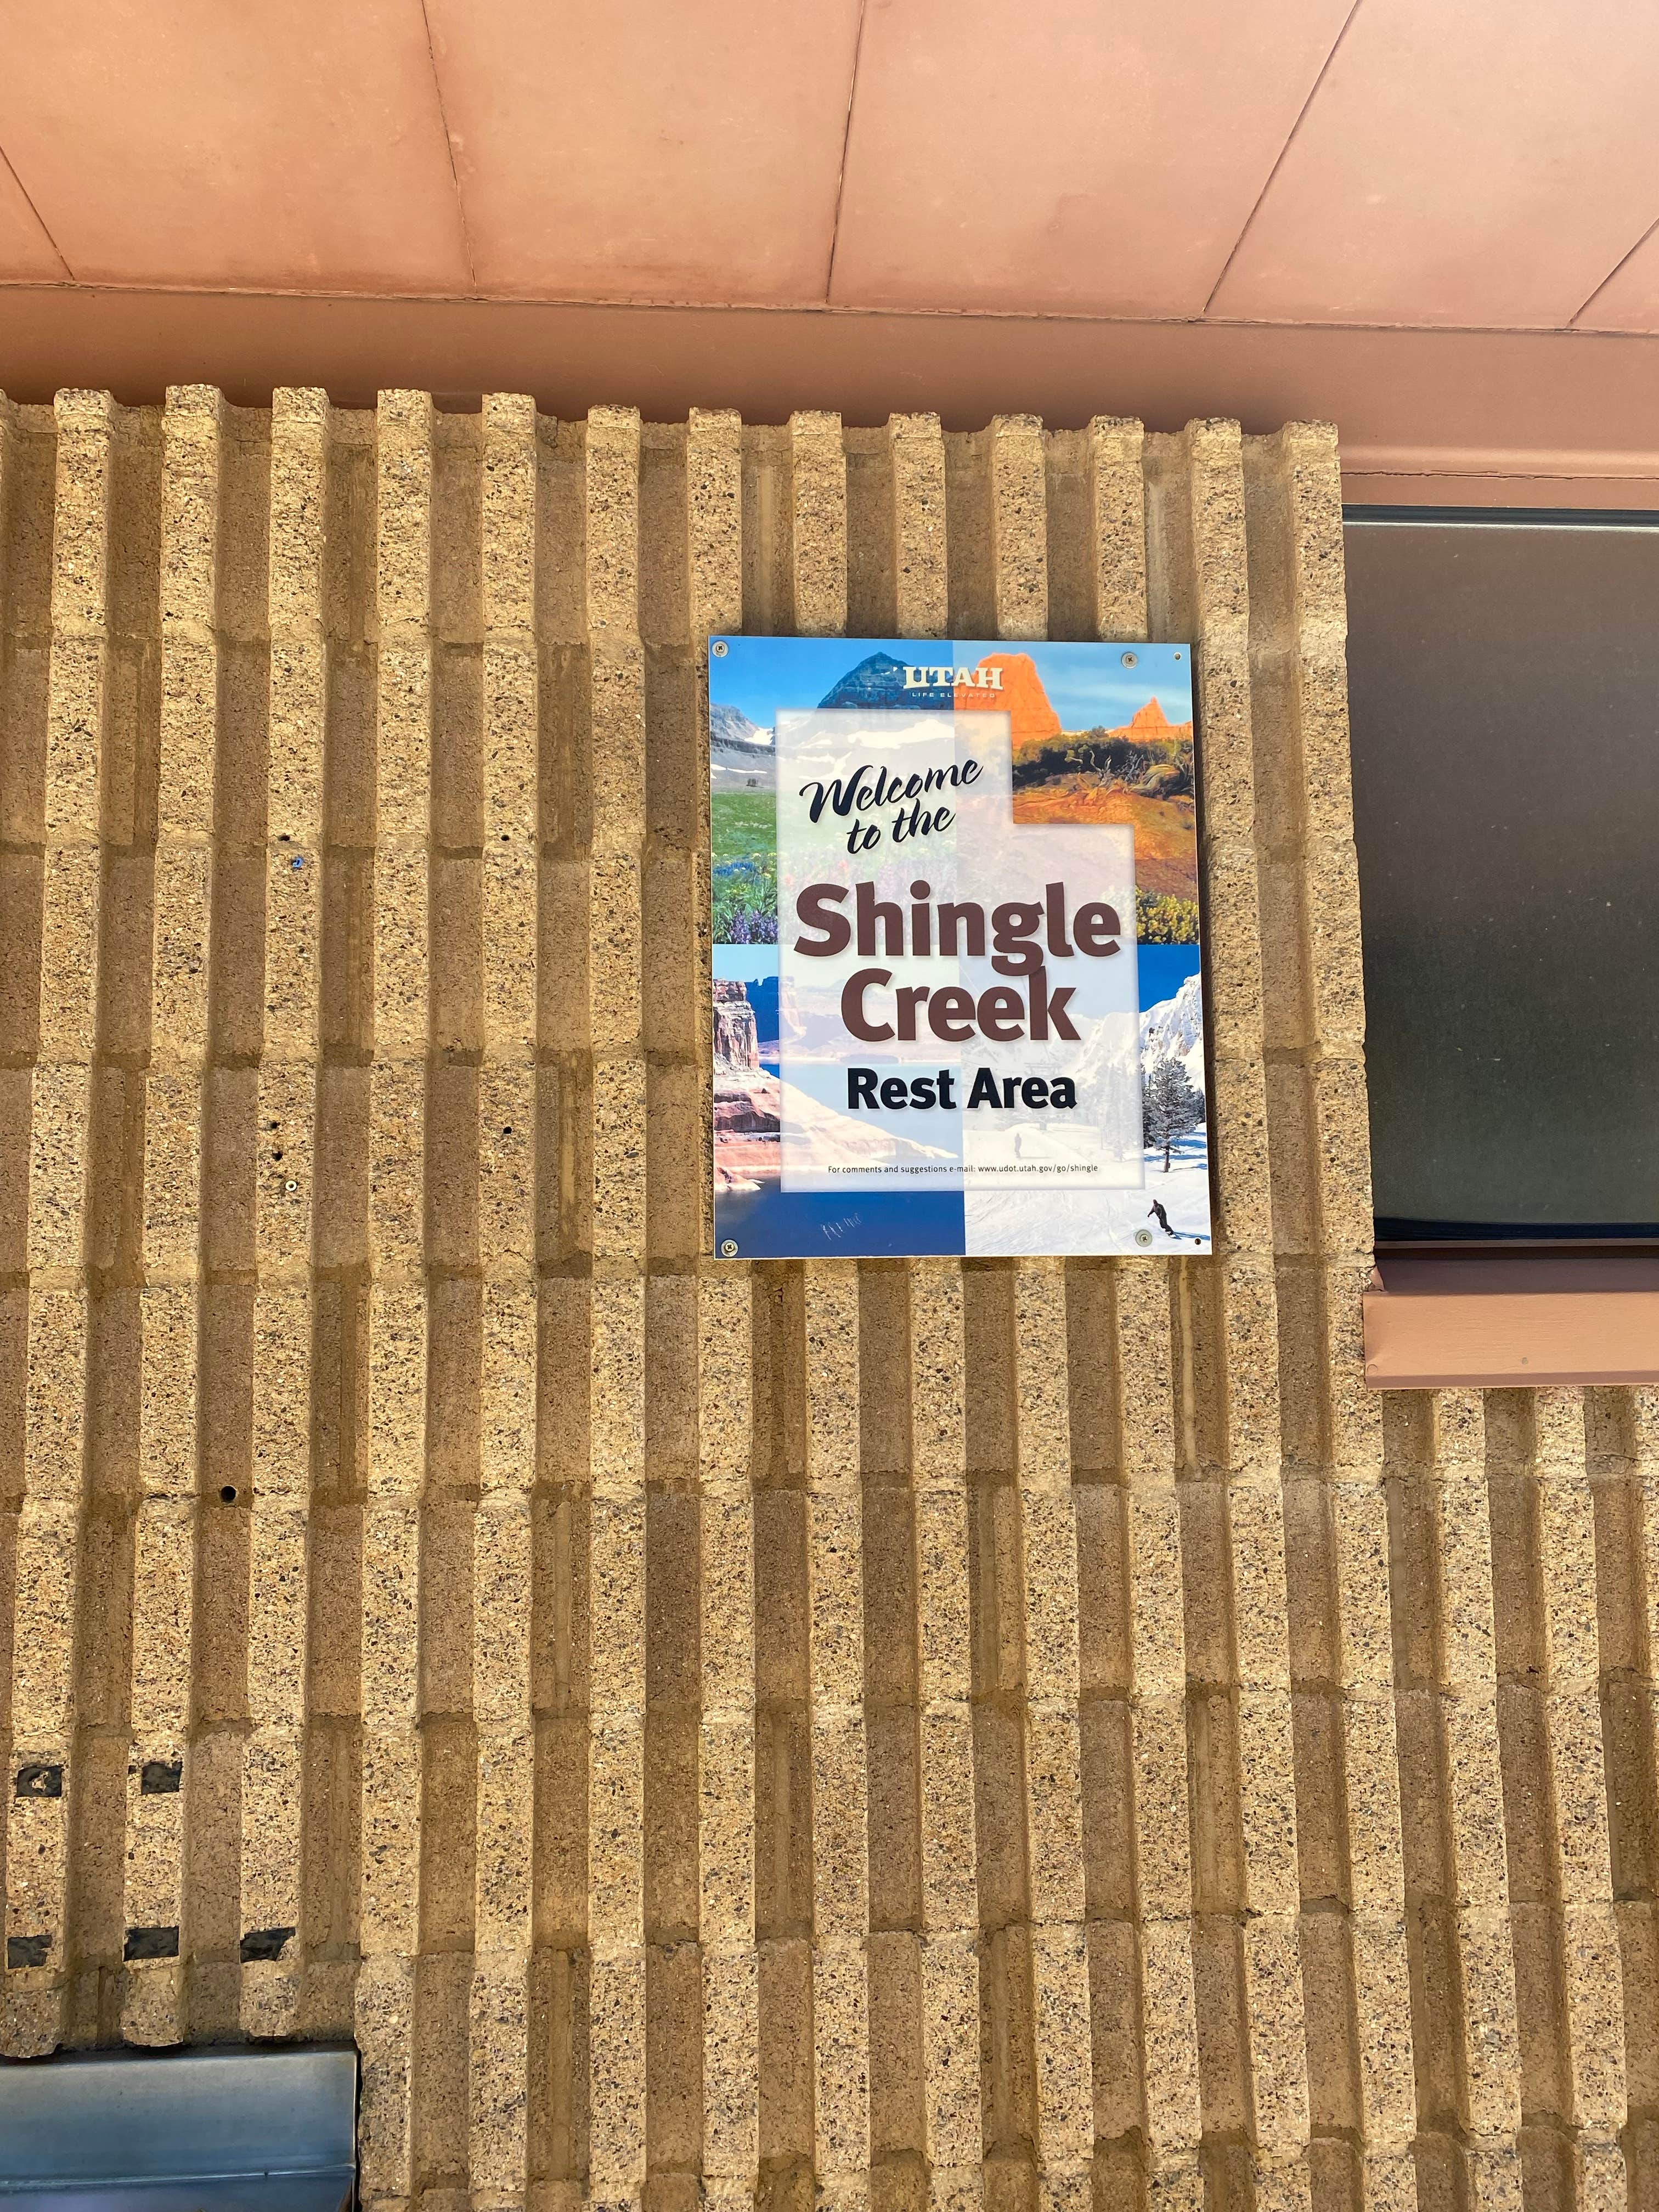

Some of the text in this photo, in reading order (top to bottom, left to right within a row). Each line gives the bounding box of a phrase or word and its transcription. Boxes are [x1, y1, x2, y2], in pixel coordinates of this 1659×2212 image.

[903, 667, 1003, 690] UTAH
[799, 759, 984, 823] Welcome
[847, 798, 956, 854] to the
[794, 880, 1121, 976] Shingle
[841, 966, 1081, 1041] Creek
[847, 1068, 1077, 1109] Rest Area
[901, 1165, 947, 1174] suggestions
[978, 1164, 1098, 1173] www.udot.utah.gov/go/shingle
